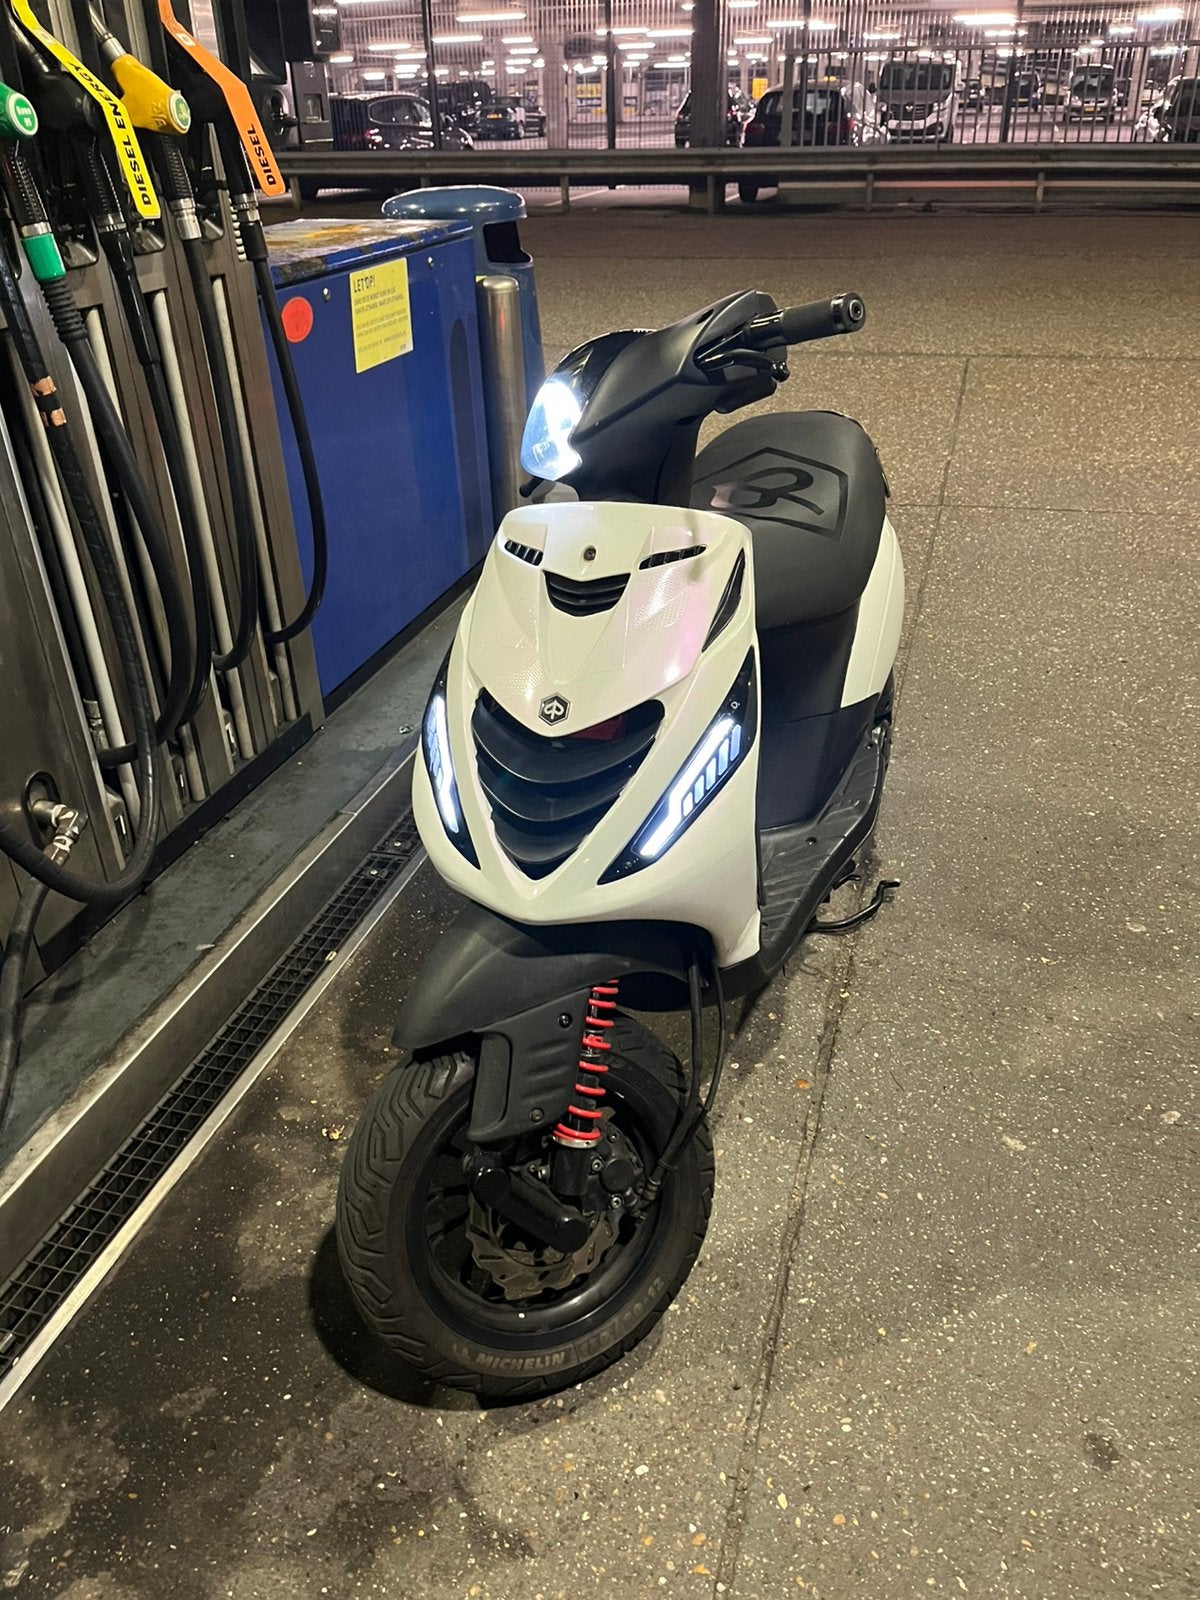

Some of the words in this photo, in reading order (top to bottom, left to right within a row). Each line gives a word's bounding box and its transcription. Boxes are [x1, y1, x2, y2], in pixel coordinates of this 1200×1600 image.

[69, 61, 127, 130] ENERGY
[123, 134, 152, 206] DIESEL
[247, 123, 277, 186] DIESEL
[475, 1351, 566, 1371] MICHELIN
